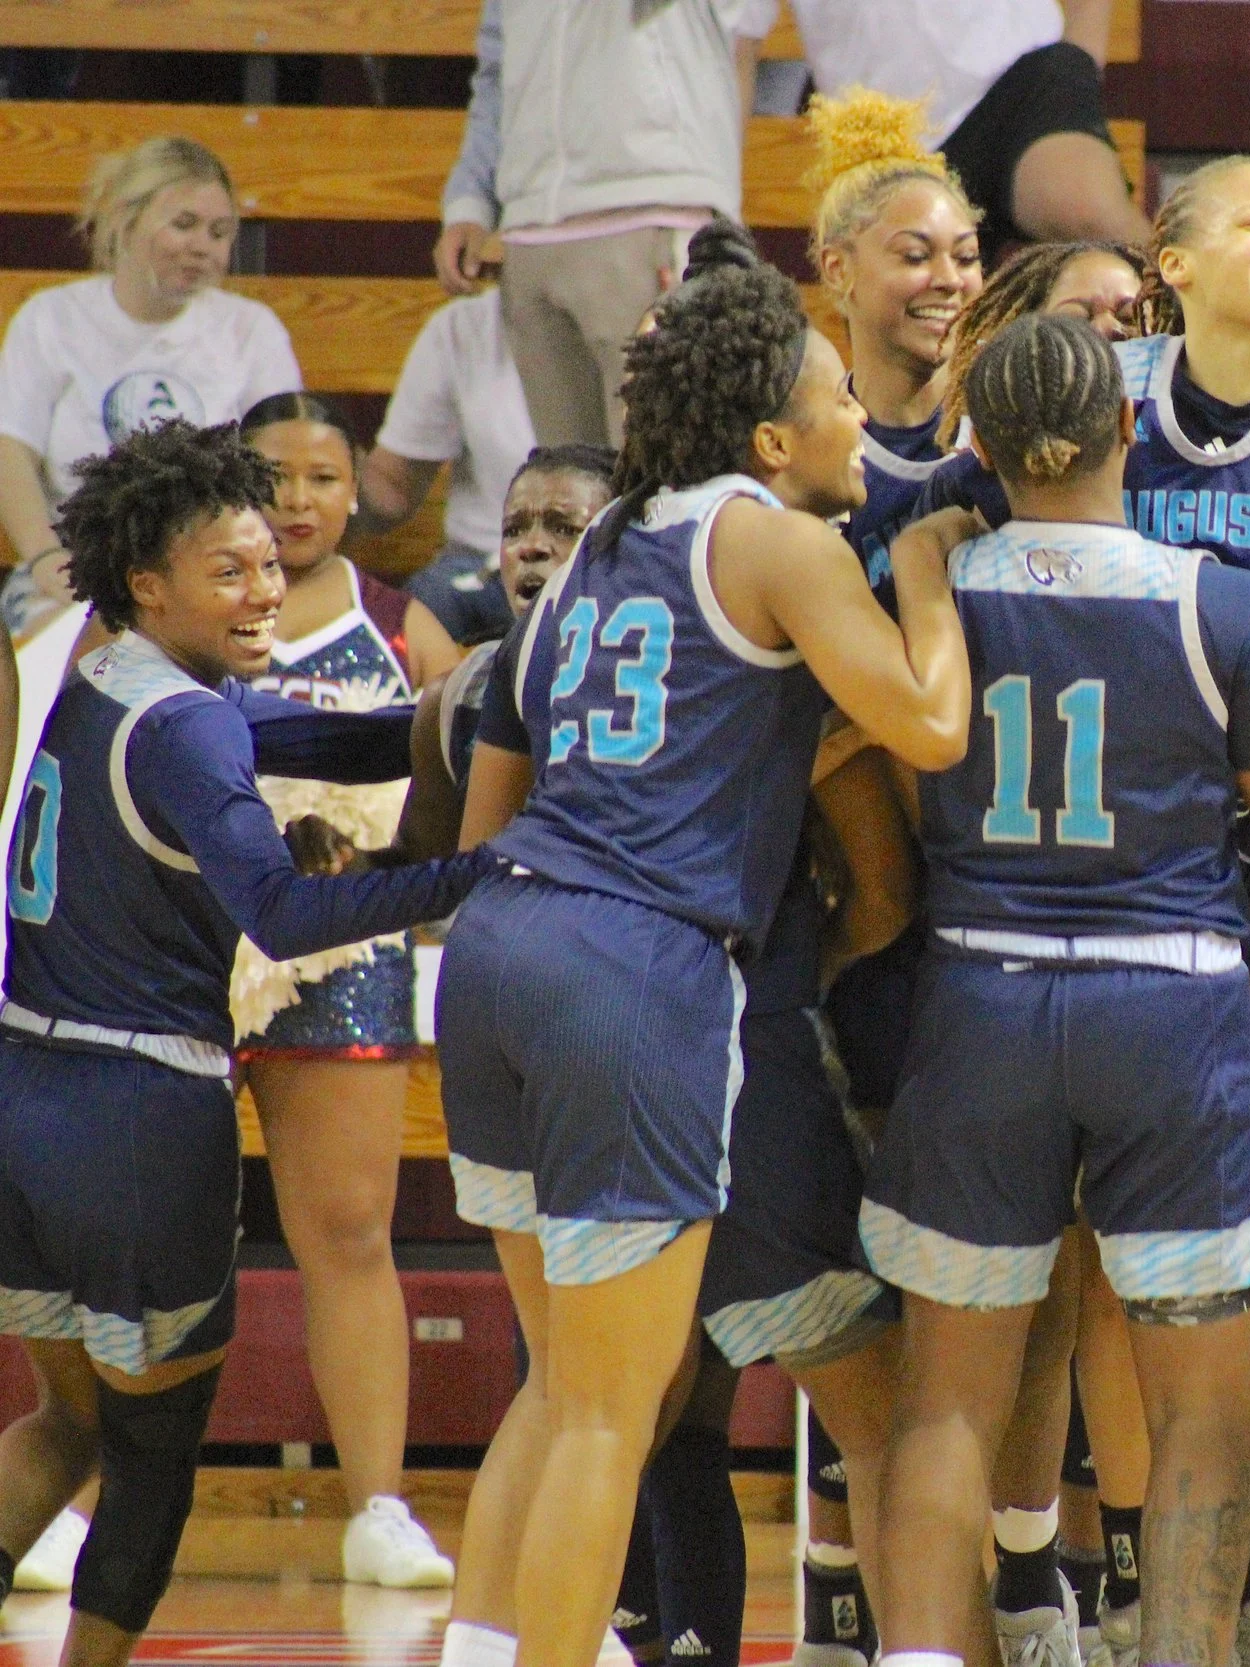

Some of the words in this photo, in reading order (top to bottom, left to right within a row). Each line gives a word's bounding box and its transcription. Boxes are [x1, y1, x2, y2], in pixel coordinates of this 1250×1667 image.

[548, 596, 675, 768] 23
[982, 673, 1115, 849] 11
[7, 748, 63, 927] 0
